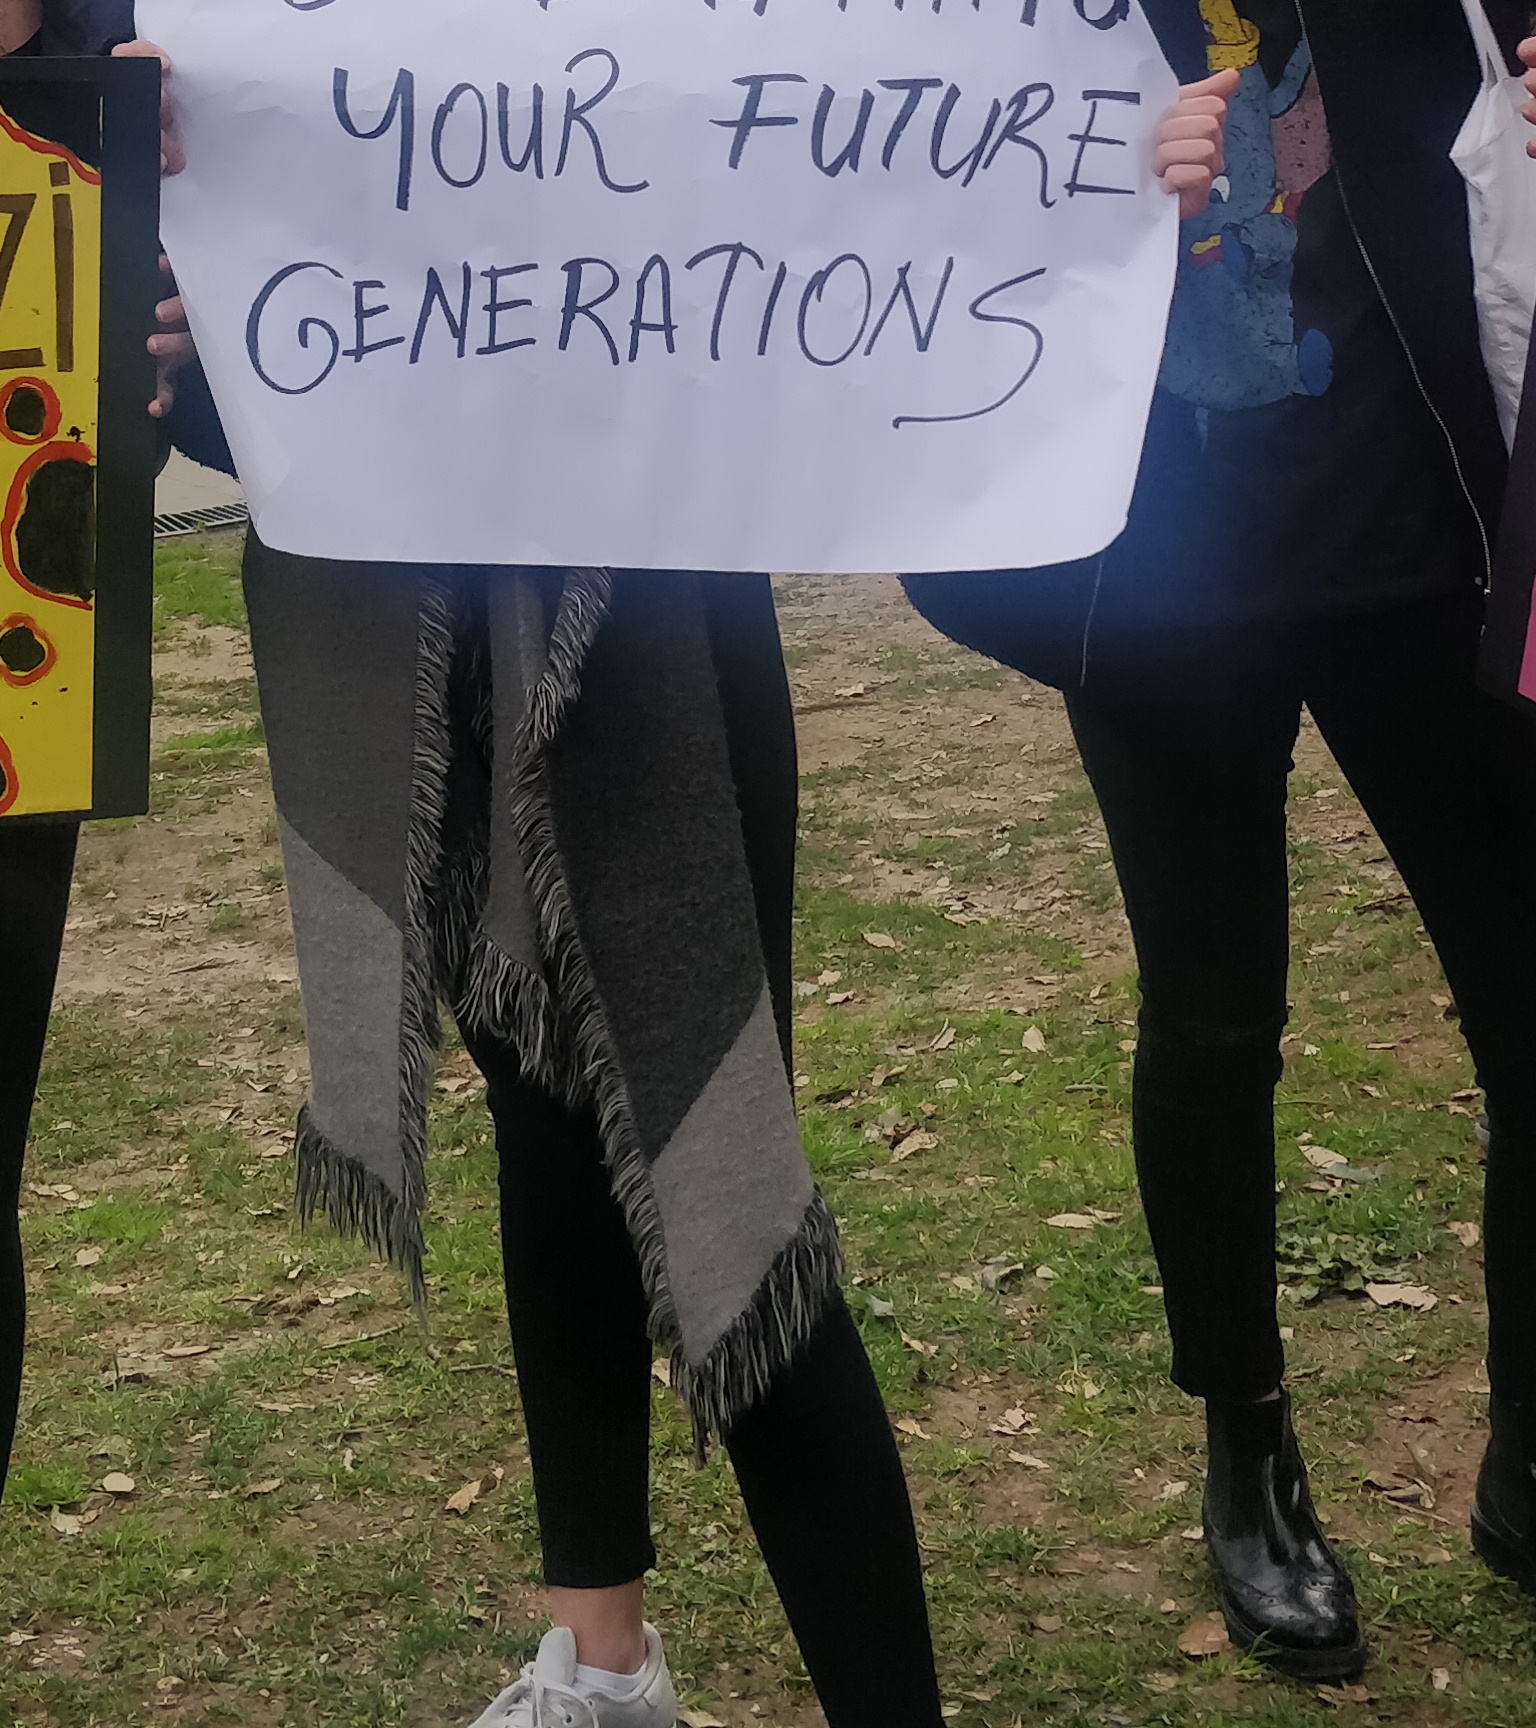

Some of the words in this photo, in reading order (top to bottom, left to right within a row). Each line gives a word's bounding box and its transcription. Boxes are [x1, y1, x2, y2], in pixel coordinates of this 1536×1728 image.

[333, 48, 651, 212] YOUR
[709, 73, 1141, 209] FUTURE
[246, 241, 1048, 429] GENERATIONS
